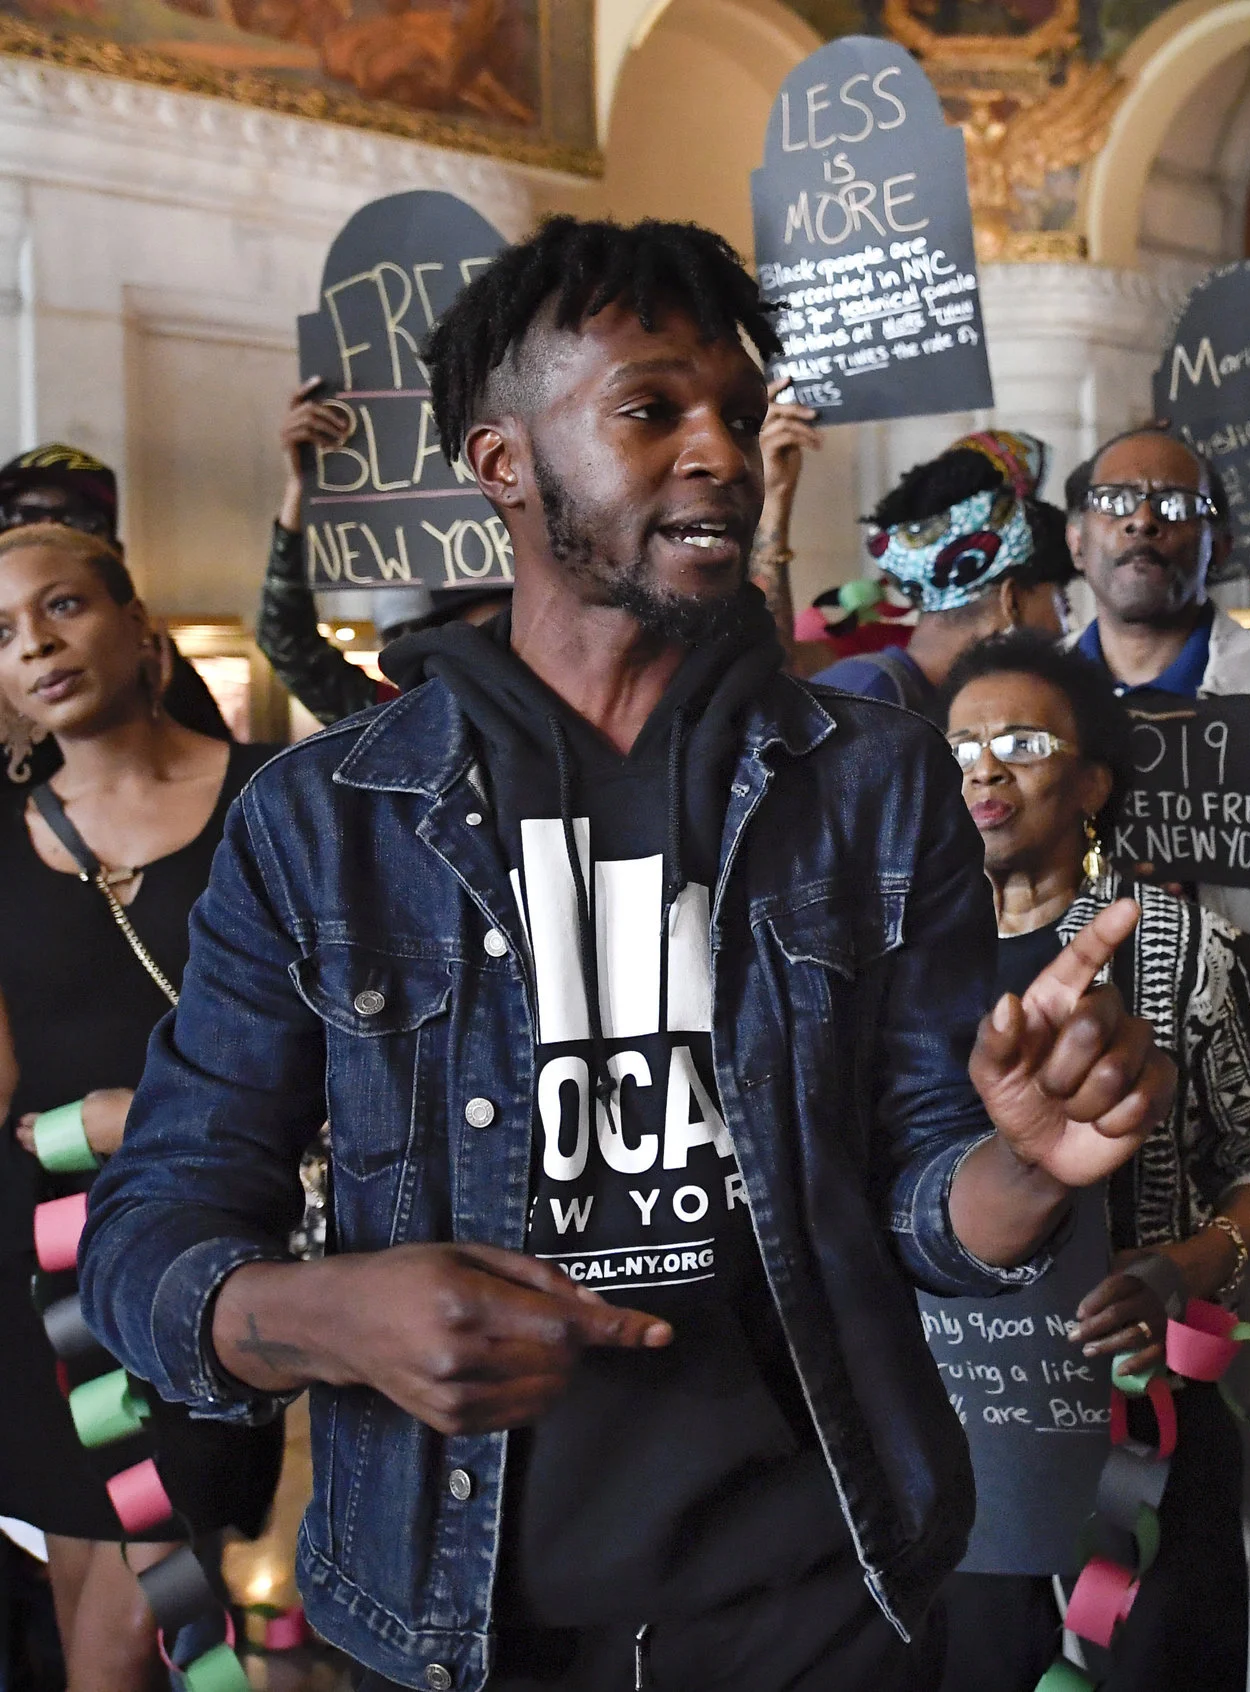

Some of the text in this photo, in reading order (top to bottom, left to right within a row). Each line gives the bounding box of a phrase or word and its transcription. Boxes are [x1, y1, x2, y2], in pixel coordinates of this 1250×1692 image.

[781, 66, 907, 152] LESS
[823, 150, 856, 184] is
[783, 172, 930, 246] MORE
[758, 236, 927, 290] Black people are
[875, 270, 900, 289] in
[901, 249, 956, 285] NYC
[838, 283, 922, 325] technical
[921, 272, 977, 311] parole
[324, 257, 495, 391] FR
[782, 327, 850, 357] olations
[852, 322, 874, 343] at
[891, 342, 920, 360] the
[316, 398, 477, 492] BLA
[306, 516, 513, 587] NEW YOR
[1157, 791, 1192, 821] TO
[1147, 822, 1217, 864] NEW
[537, 1045, 737, 1183] OCA
[628, 1172, 748, 1227] YOR
[557, 1248, 714, 1281] CAL-NY.ORG
[967, 1311, 1035, 1343] 9,000
[1045, 1314, 1079, 1337] Ne
[1010, 1365, 1029, 1382] a
[1041, 1359, 1095, 1385] life
[982, 1405, 1033, 1425] are
[1048, 1398, 1112, 1428] Blac
